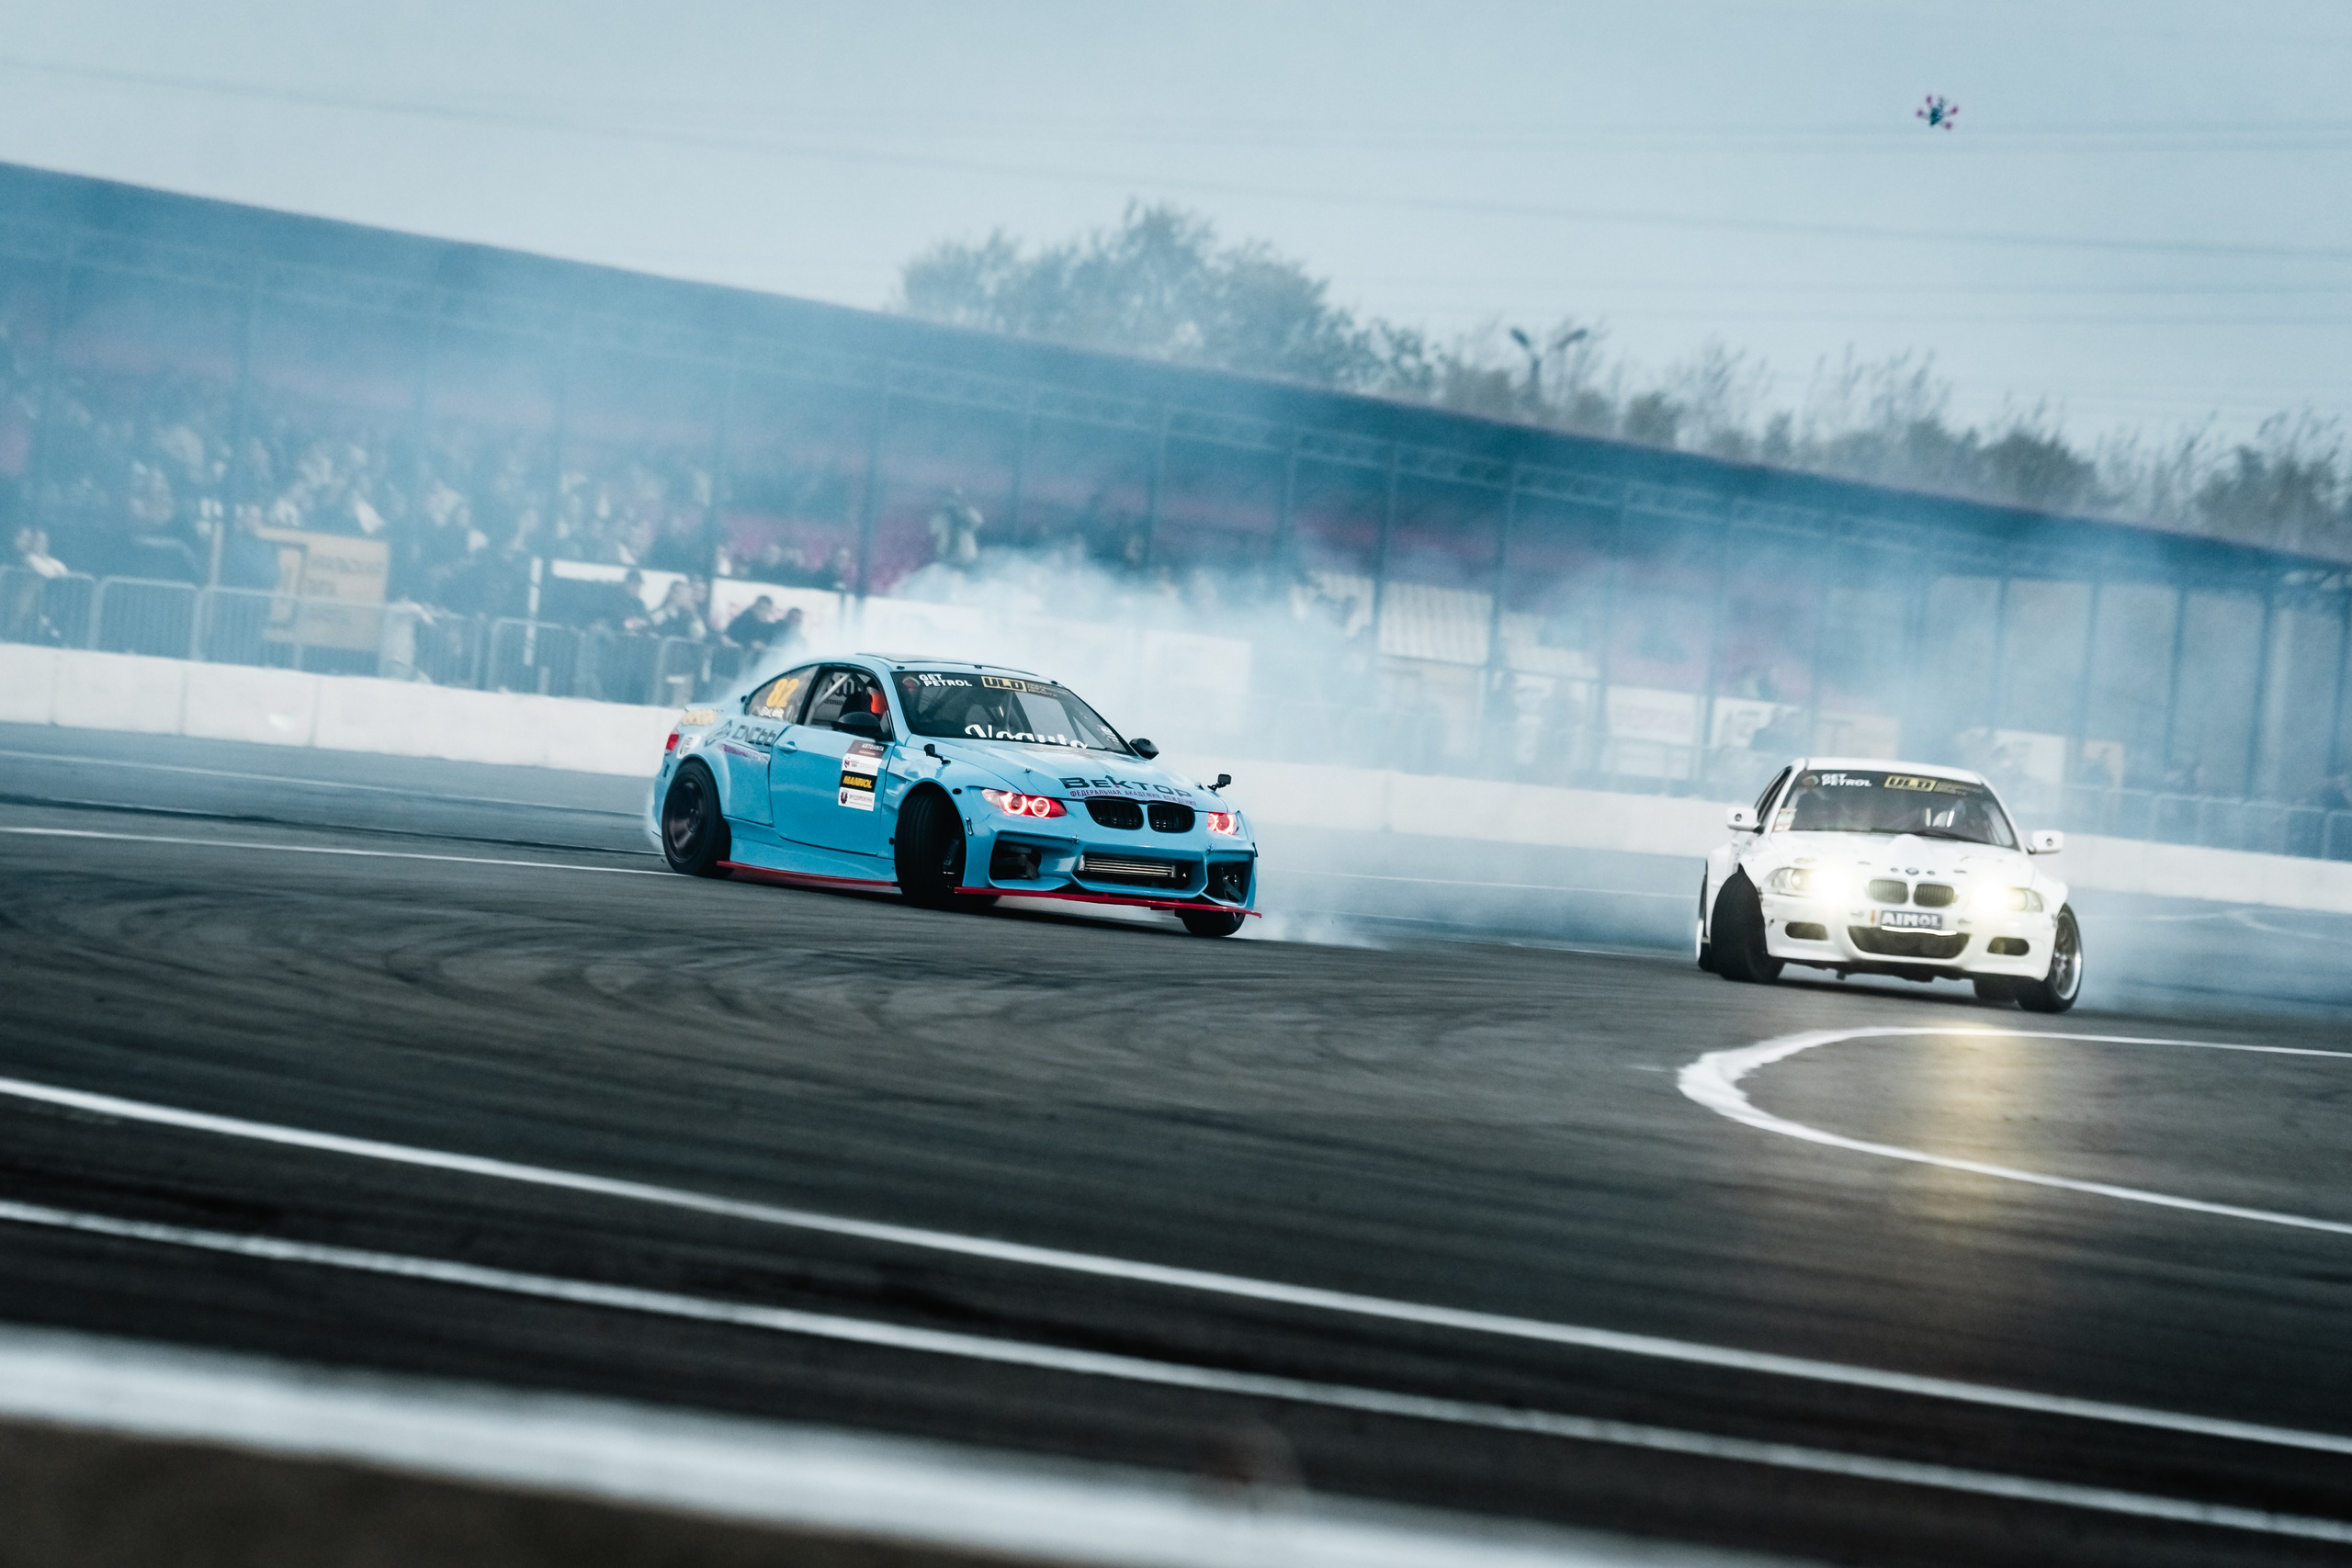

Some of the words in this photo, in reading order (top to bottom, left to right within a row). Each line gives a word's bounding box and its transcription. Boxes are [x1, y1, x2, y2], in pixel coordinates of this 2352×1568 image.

[983, 677, 1023, 691] ULD
[766, 678, 799, 708] 82
[1822, 778, 1872, 787] PETROL
[1069, 789, 1122, 797] ФЕДЕРАЛЬНАЯ
[1882, 911, 1940, 927] AIMOL
